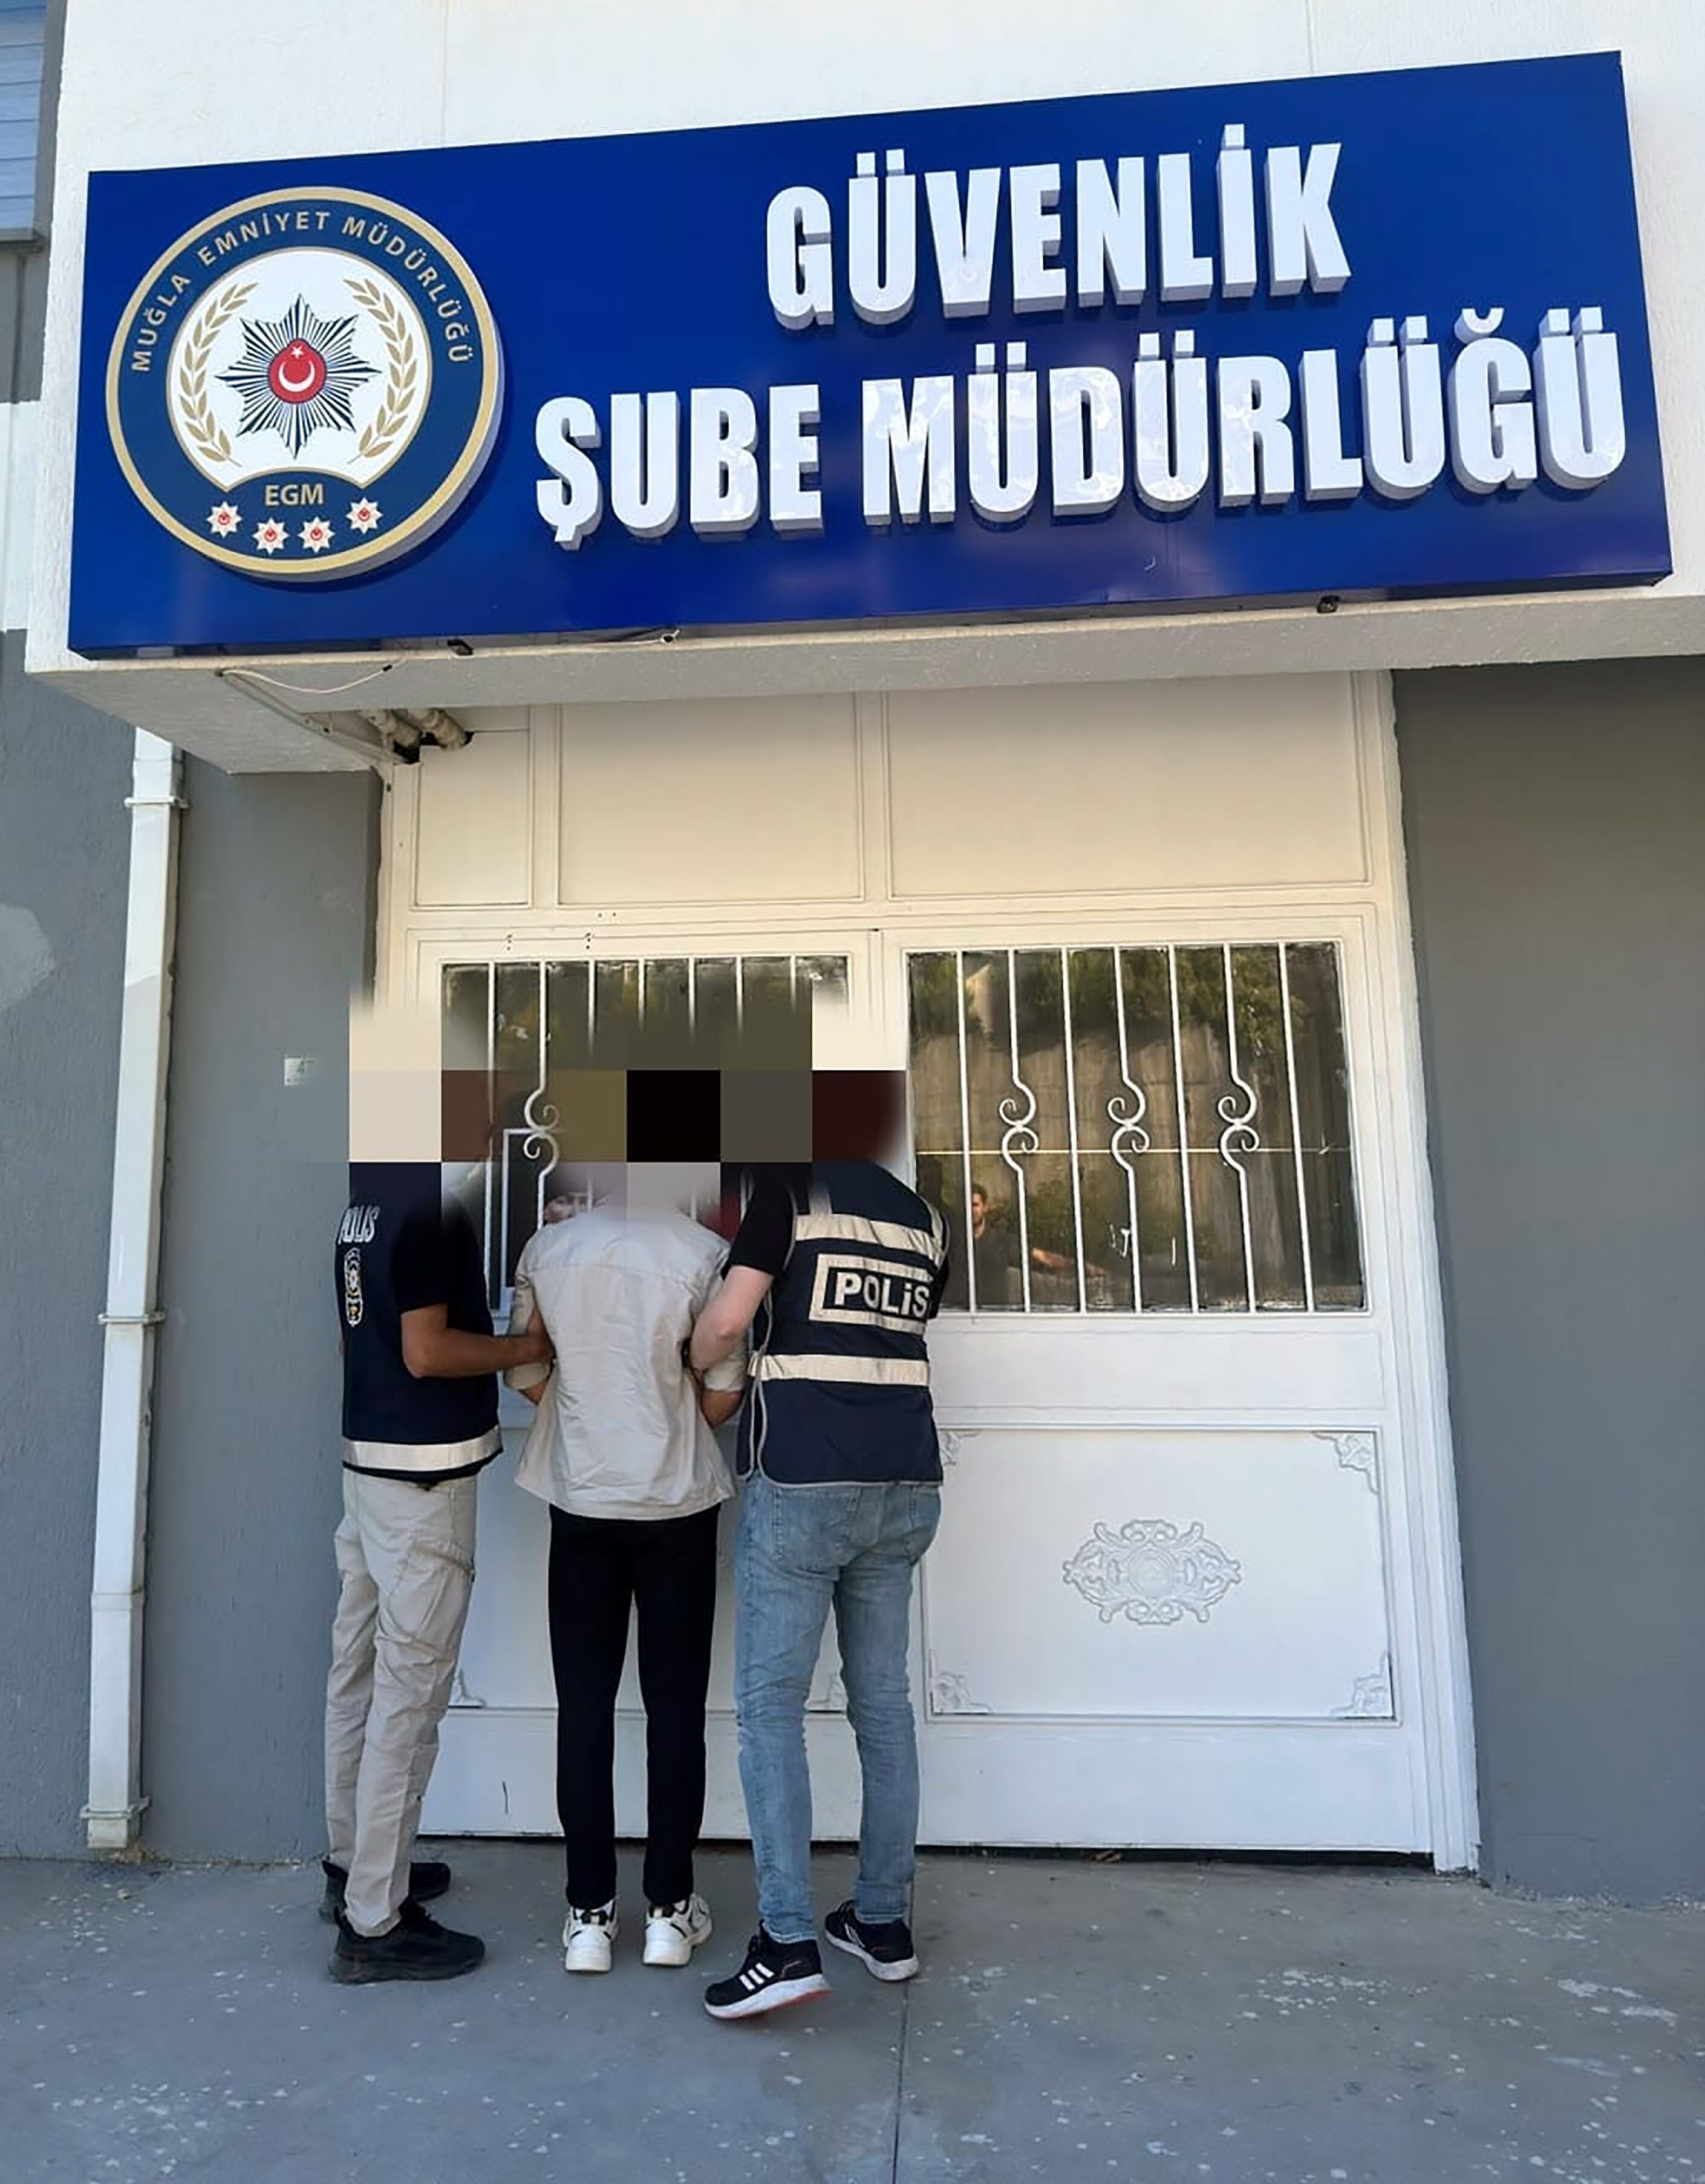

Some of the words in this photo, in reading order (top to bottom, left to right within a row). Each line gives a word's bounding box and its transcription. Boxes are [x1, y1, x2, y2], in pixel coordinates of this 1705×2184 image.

[131, 275, 191, 373] MUĞLA
[198, 212, 331, 266] EMNİYET
[344, 216, 474, 364] MÜDÜRLÜĞÜ
[767, 124, 1352, 330] GÜVENLİK
[264, 485, 324, 506] EGM
[535, 385, 822, 549] ŞUBE
[862, 307, 1627, 525] MÜDÜRLÜĞÜ
